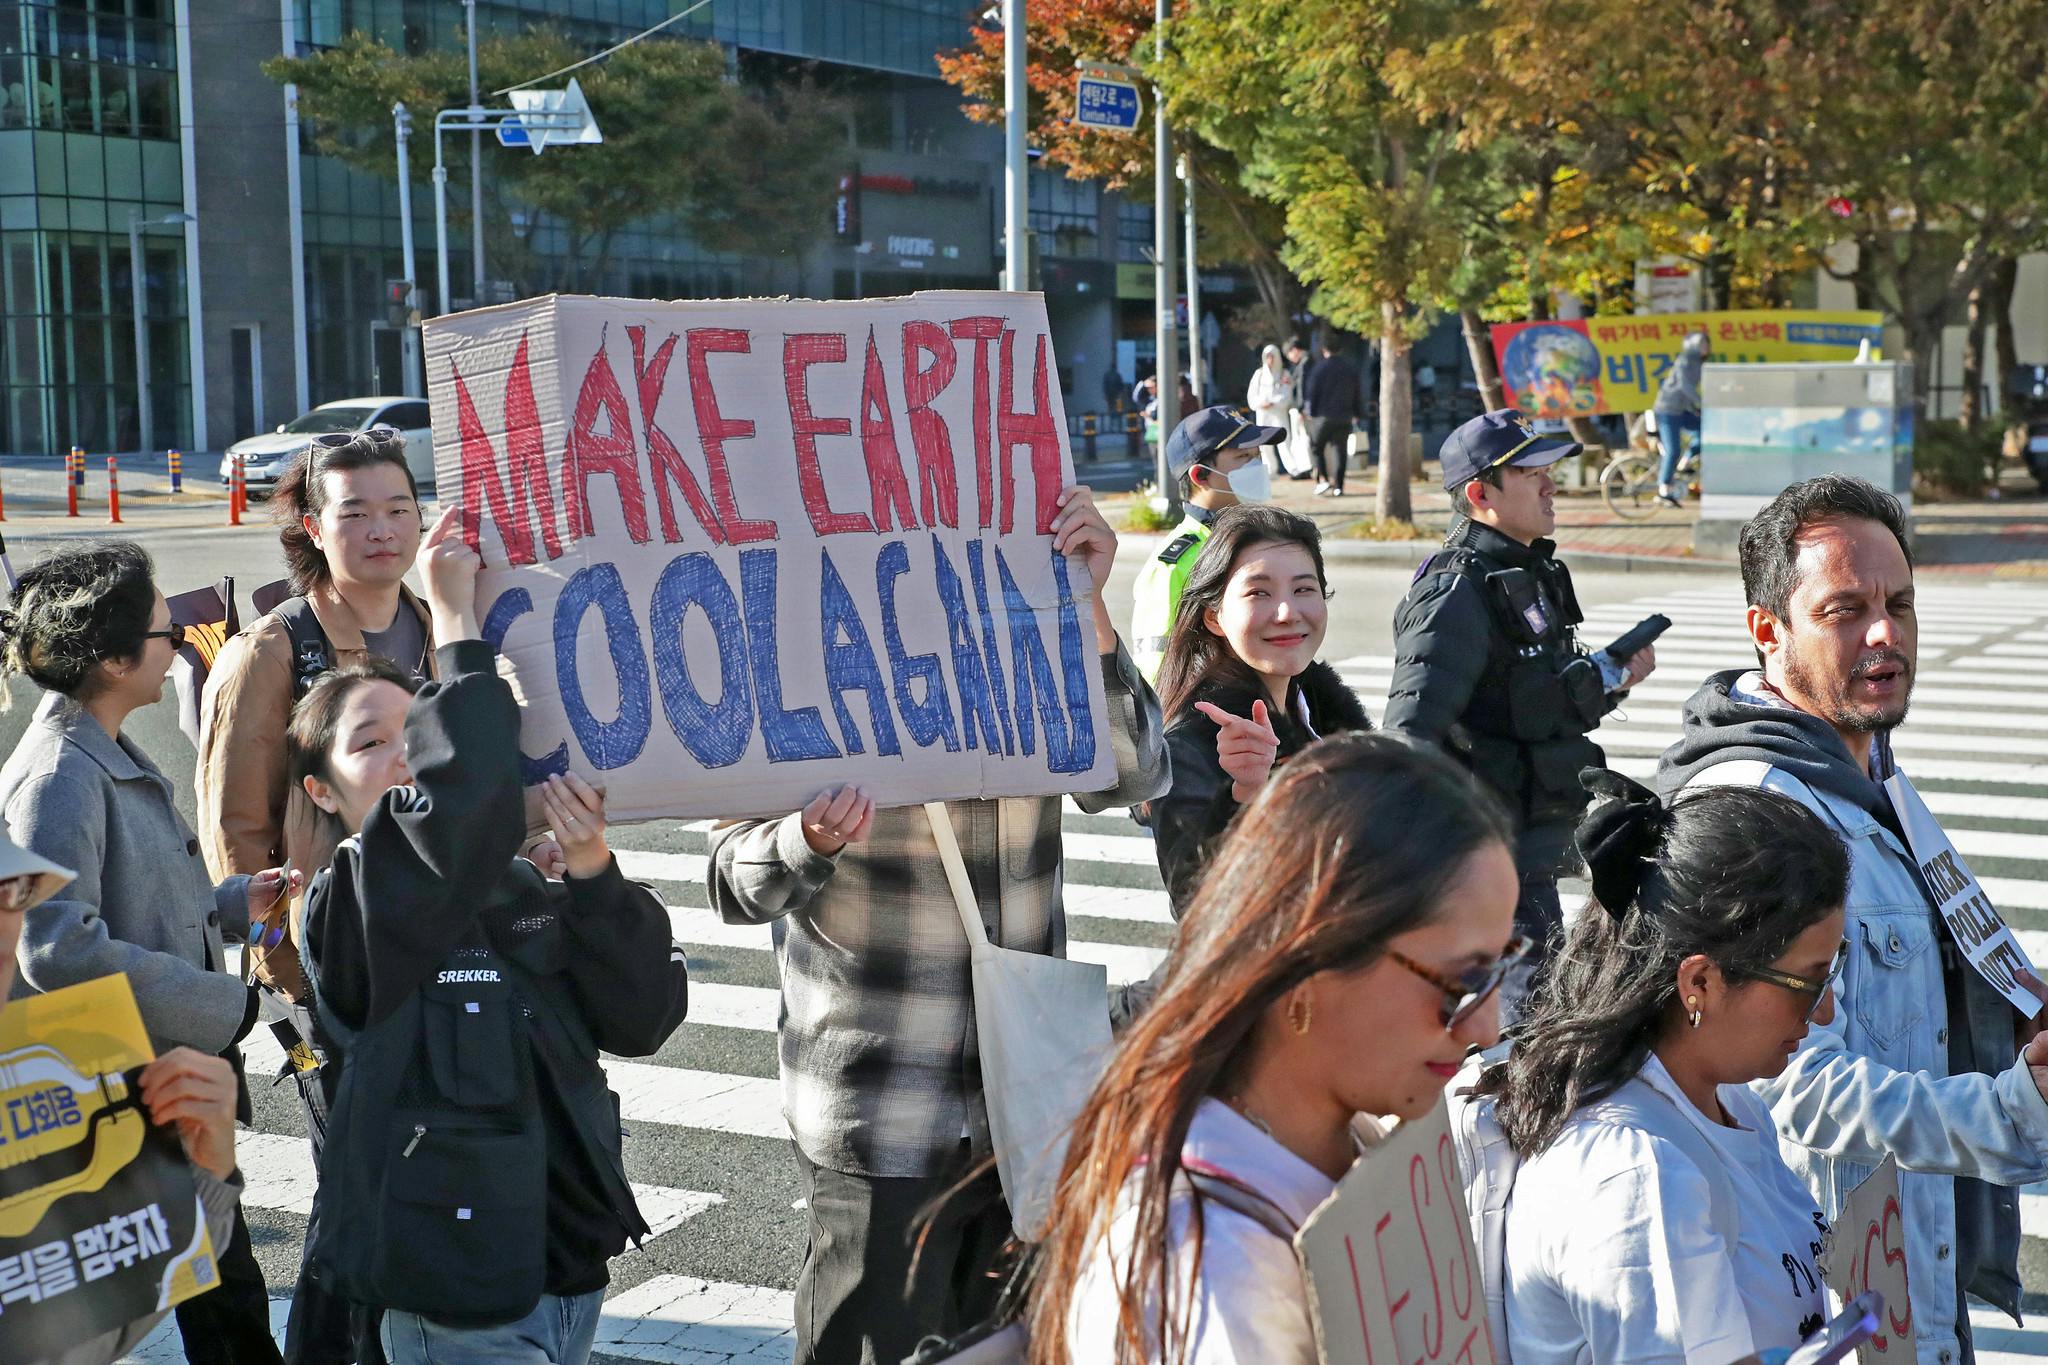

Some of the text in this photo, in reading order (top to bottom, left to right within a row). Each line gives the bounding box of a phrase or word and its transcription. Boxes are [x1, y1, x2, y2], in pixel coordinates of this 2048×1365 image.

[1596, 322, 1662, 344] 위기의
[1717, 319, 1782, 343] 온난화
[449, 315, 1064, 569] MAKE EARTH
[821, 533, 1094, 775] AGAIN
[1921, 849, 1972, 906] KICK
[6, 1085, 82, 1141] 다회용
[0, 1240, 79, 1308] 틱을
[72, 1203, 172, 1283] 멈추자
